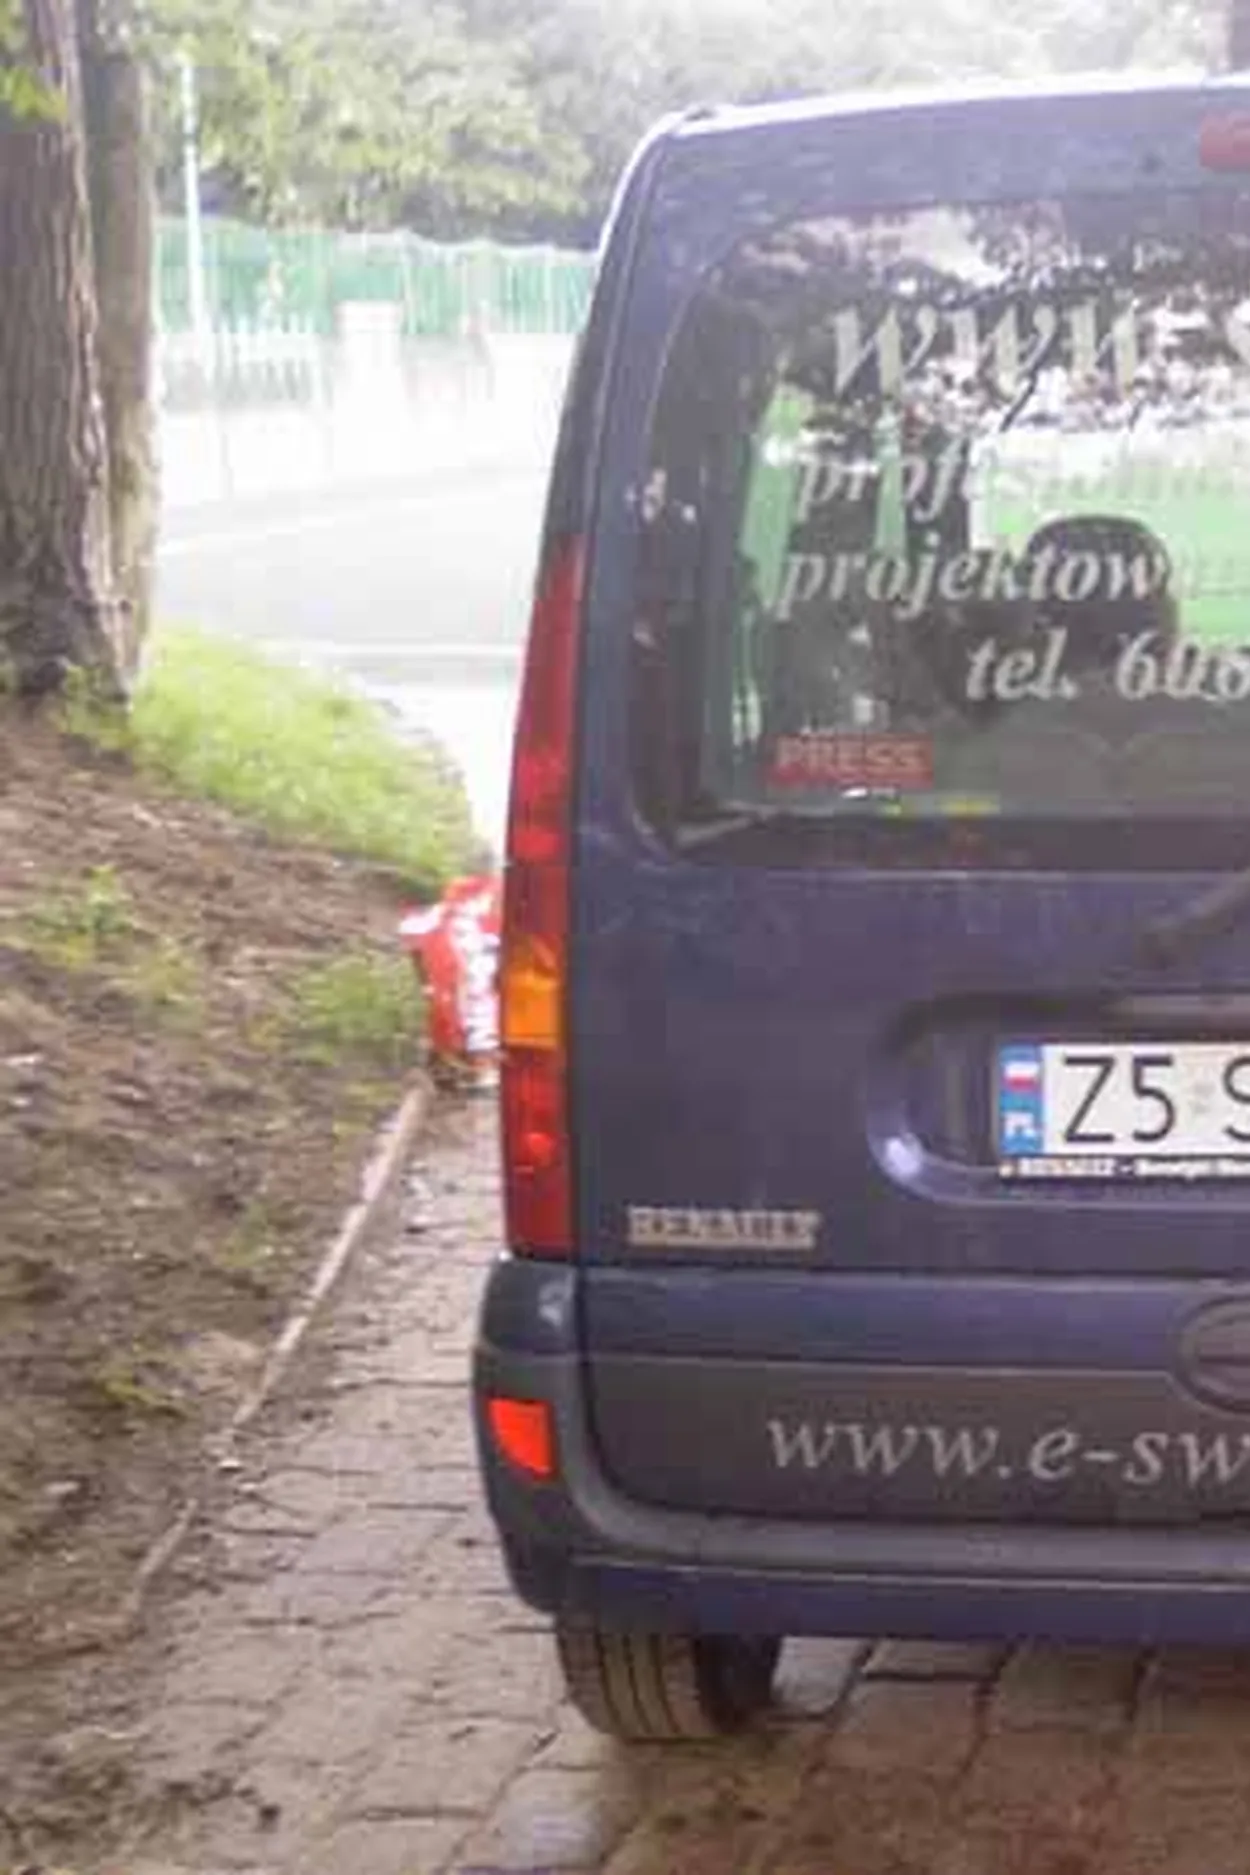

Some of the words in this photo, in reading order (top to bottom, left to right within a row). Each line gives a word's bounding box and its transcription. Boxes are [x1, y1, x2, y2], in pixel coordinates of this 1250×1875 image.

[967, 627, 1077, 699] tel.
[776, 738, 924, 774] PRESS
[1062, 1055, 1177, 1143] Z5
